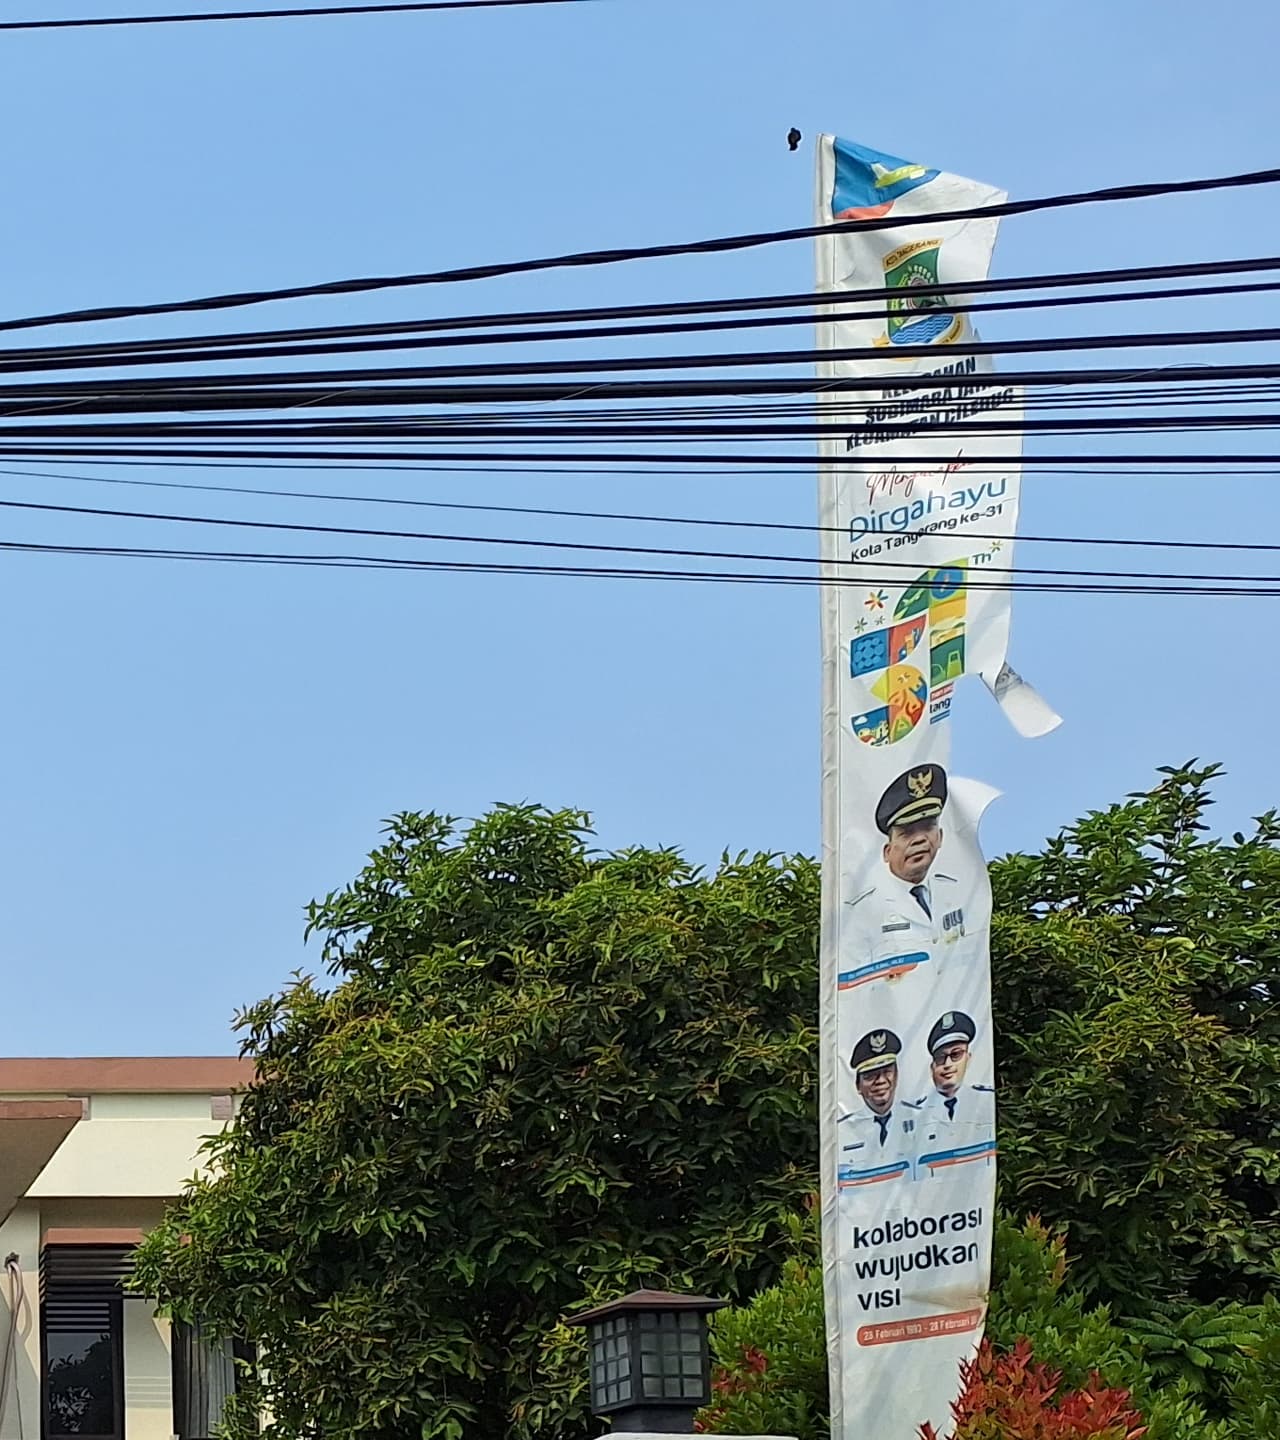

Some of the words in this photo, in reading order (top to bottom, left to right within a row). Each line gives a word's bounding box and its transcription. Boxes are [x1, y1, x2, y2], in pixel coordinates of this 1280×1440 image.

[849, 477, 1007, 543] Dirgahayu
[851, 544, 883, 563] Kota
[883, 514, 957, 551] Tangerang
[959, 502, 1004, 525] ke-31
[853, 1207, 983, 1249] kolaborasi
[855, 1242, 979, 1282] wujudkan
[856, 1288, 901, 1311] visi
